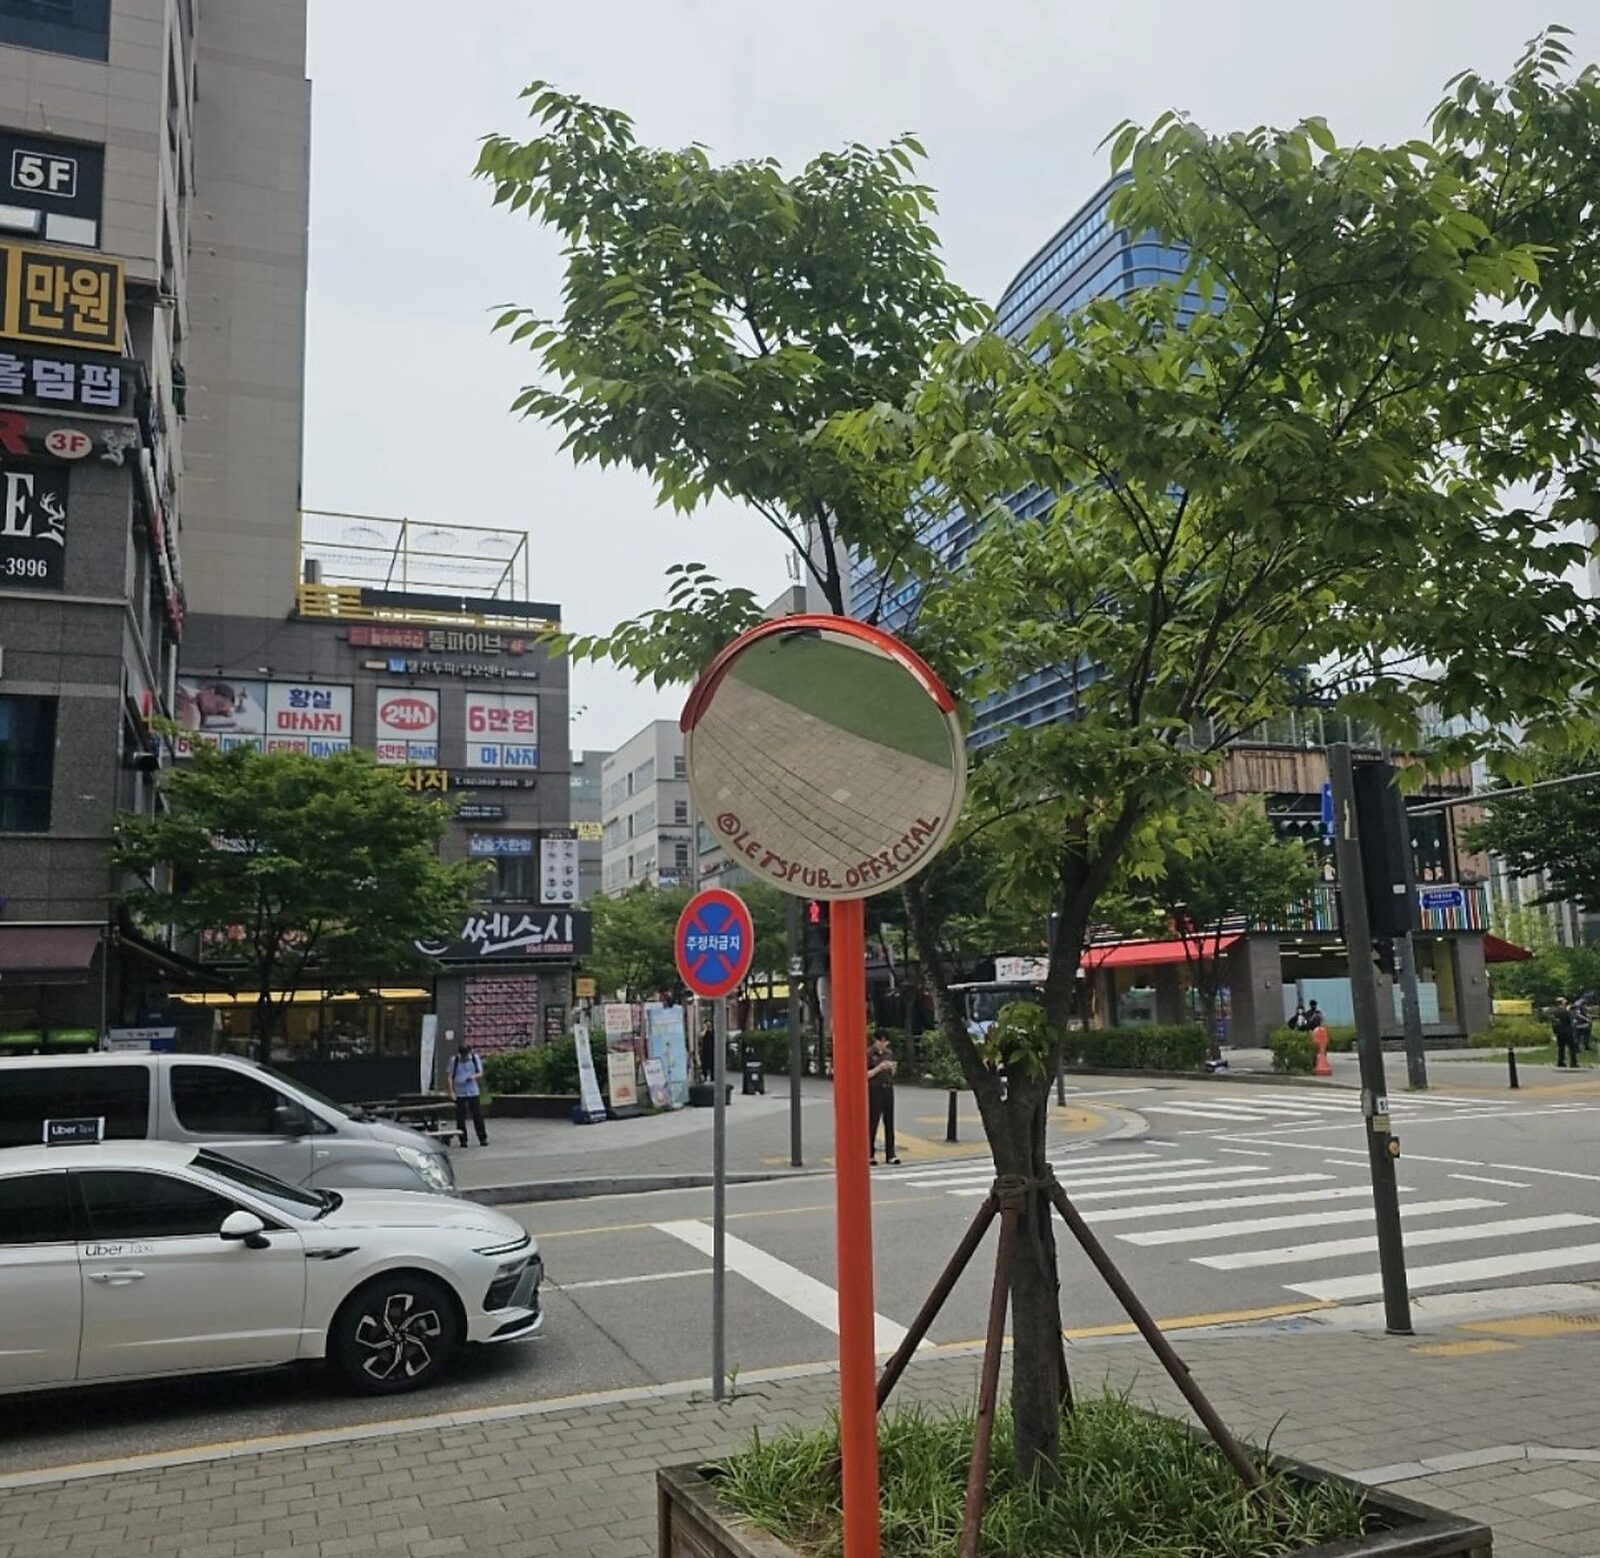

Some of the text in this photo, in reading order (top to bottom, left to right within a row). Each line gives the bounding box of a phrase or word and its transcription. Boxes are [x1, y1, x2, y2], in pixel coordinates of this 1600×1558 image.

[17, 155, 72, 191] 5F
[26, 264, 110, 336] 만원
[51, 433, 87, 452] 3F
[1, 471, 34, 537] E
[277, 711, 342, 732] 마사지
[384, 705, 431, 725] 24시
[469, 706, 534, 733] 6만원
[394, 768, 448, 791] 사지
[686, 935, 740, 952] 주정차금지
[52, 1125, 76, 1135] Uber
[85, 1244, 122, 1257] Uber
